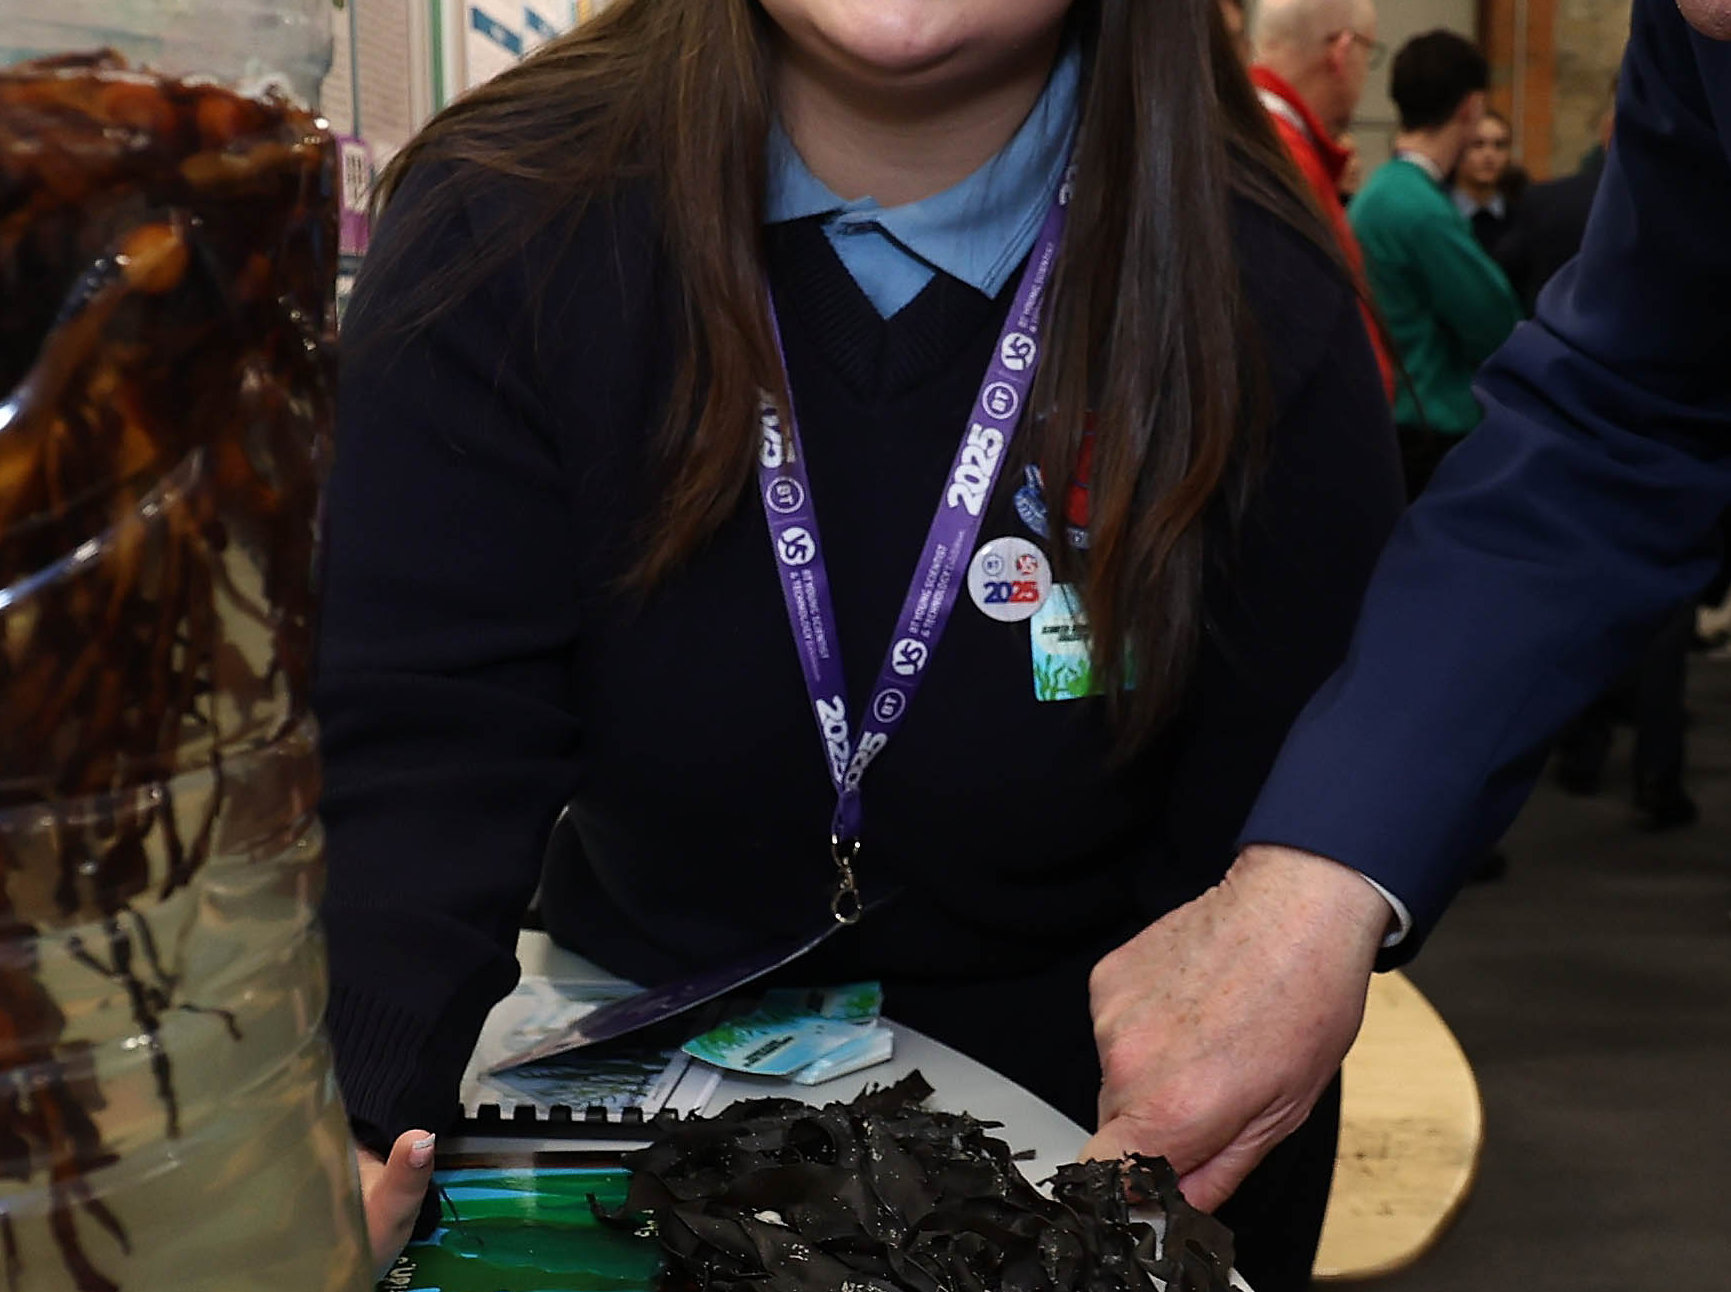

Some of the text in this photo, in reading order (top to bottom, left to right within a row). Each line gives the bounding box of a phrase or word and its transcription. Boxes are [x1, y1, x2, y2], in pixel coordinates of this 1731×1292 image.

[990, 388, 1011, 413] BT
[947, 422, 1005, 517] 2025
[982, 580, 1041, 604] 2025
[881, 695, 897, 716] BT
